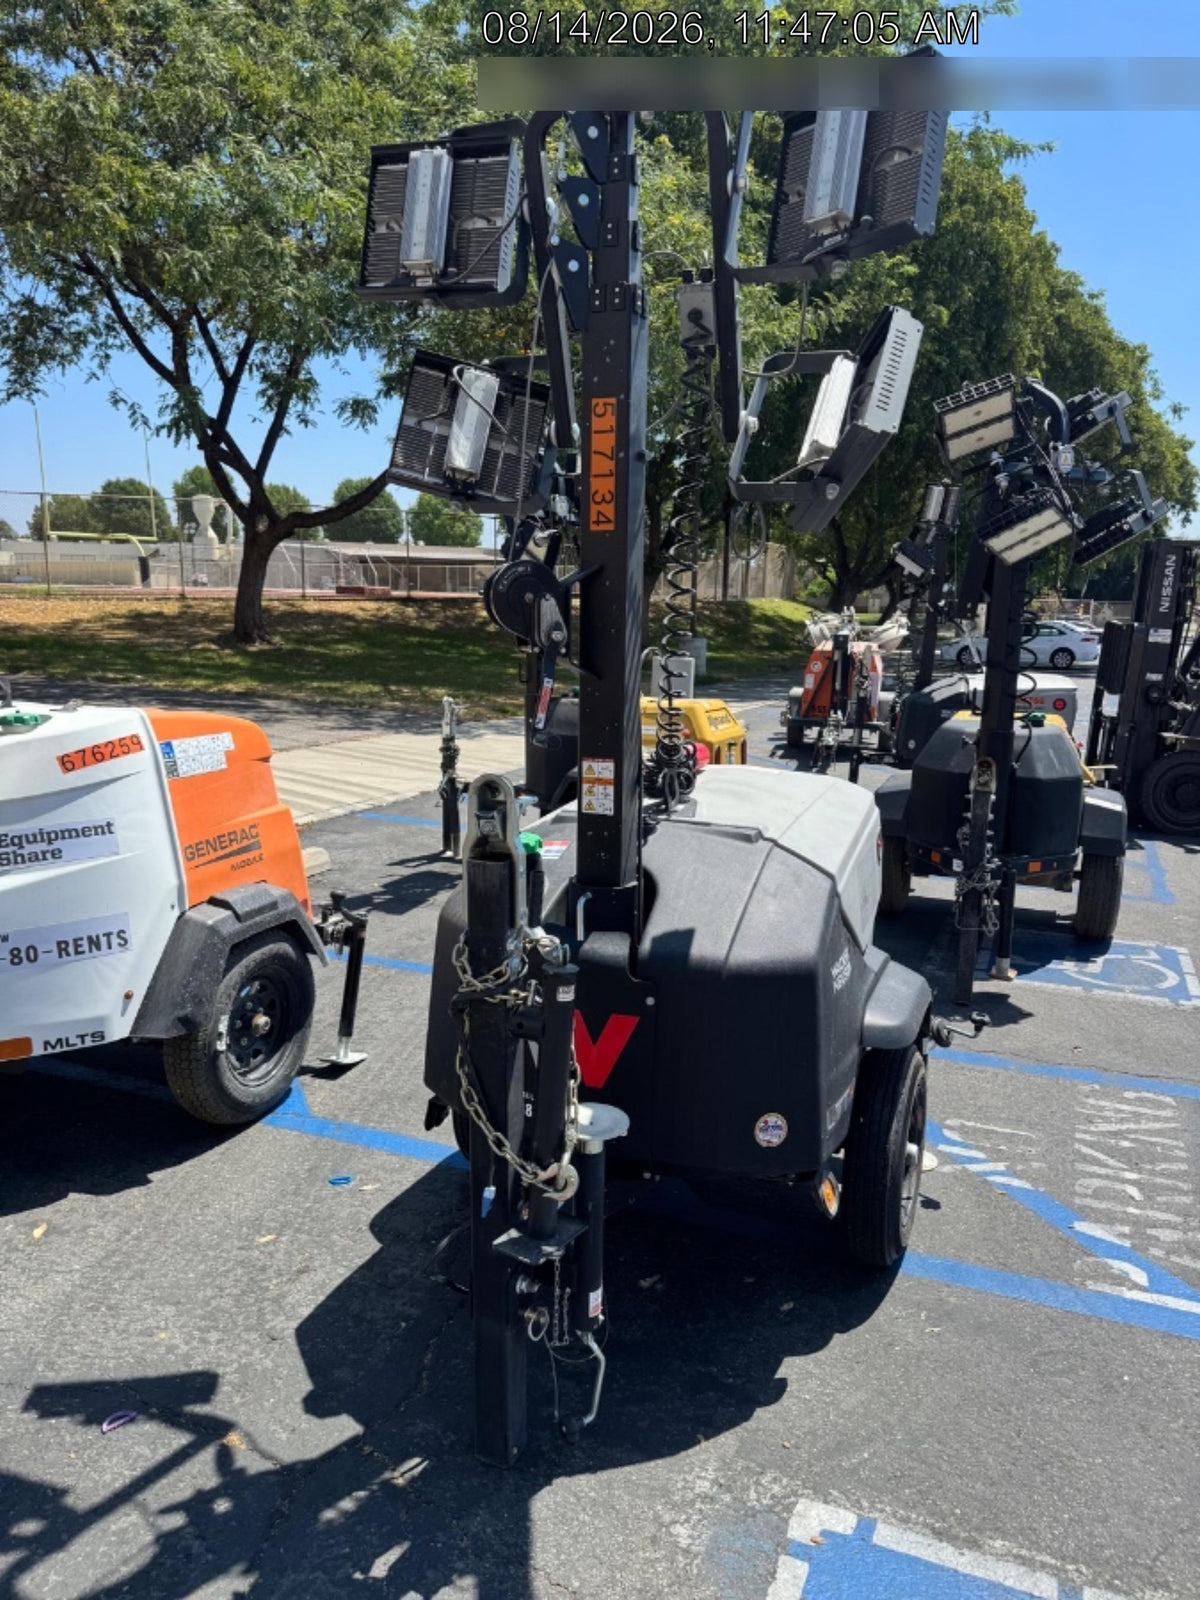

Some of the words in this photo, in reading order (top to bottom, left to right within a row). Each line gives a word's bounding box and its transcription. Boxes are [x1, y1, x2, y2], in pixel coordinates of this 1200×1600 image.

[592, 398, 615, 527] 517134
[1159, 553, 1176, 612] NISSAN
[61, 734, 144, 772] 676259
[0, 820, 114, 849] Equipment
[184, 824, 260, 862] GENERAC
[0, 847, 63, 866] Share
[43, 1030, 105, 1052] MLTS
